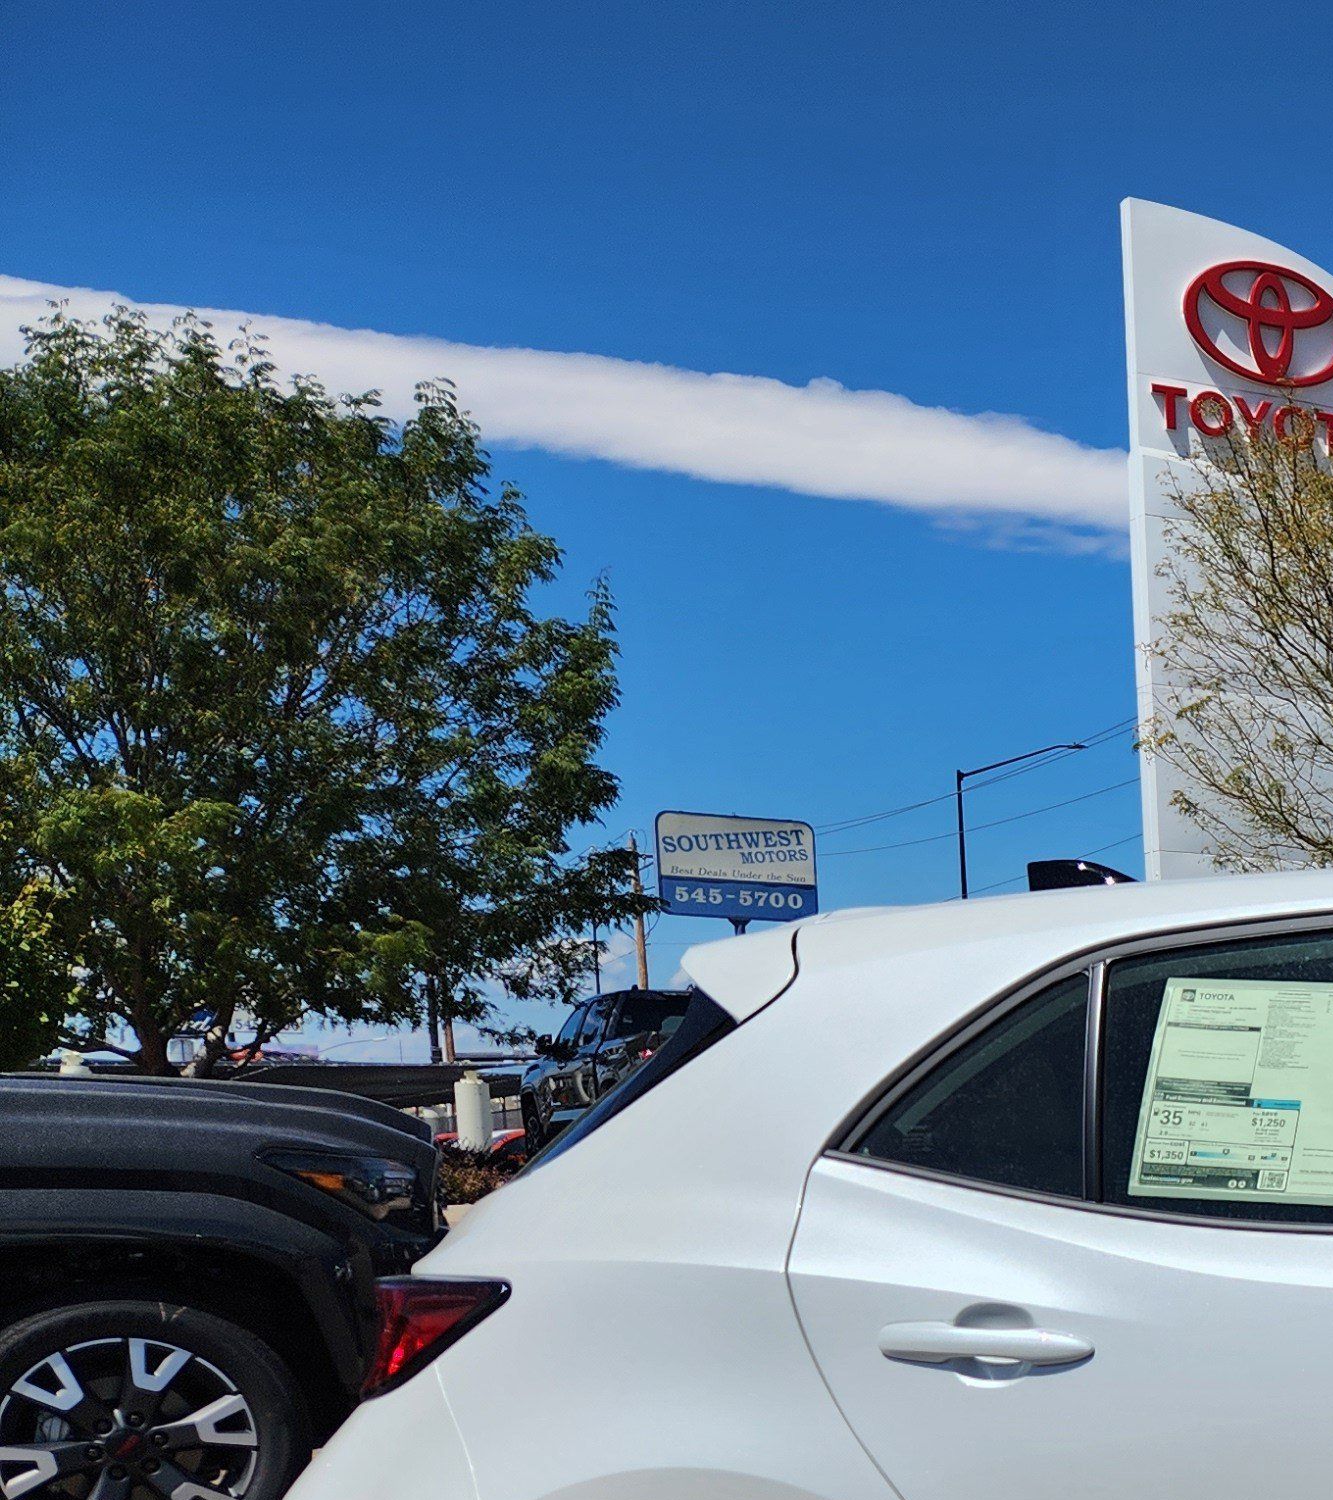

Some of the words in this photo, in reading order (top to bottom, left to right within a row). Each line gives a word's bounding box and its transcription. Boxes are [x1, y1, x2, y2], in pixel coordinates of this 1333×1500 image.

[662, 829, 805, 853] SOUTHWEST
[740, 849, 808, 864] MOTORS
[670, 865, 694, 875] Best
[698, 867, 727, 877] Deals
[732, 869, 762, 880] Under
[767, 872, 782, 882] the
[787, 873, 806, 883] Sun
[675, 886, 803, 909] 545-5700
[1199, 992, 1235, 1001] TOYOTA
[1160, 1110, 1183, 1125] 35
[1251, 1117, 1286, 1128] $1,250
[1149, 1149, 1184, 1160] $1,350
